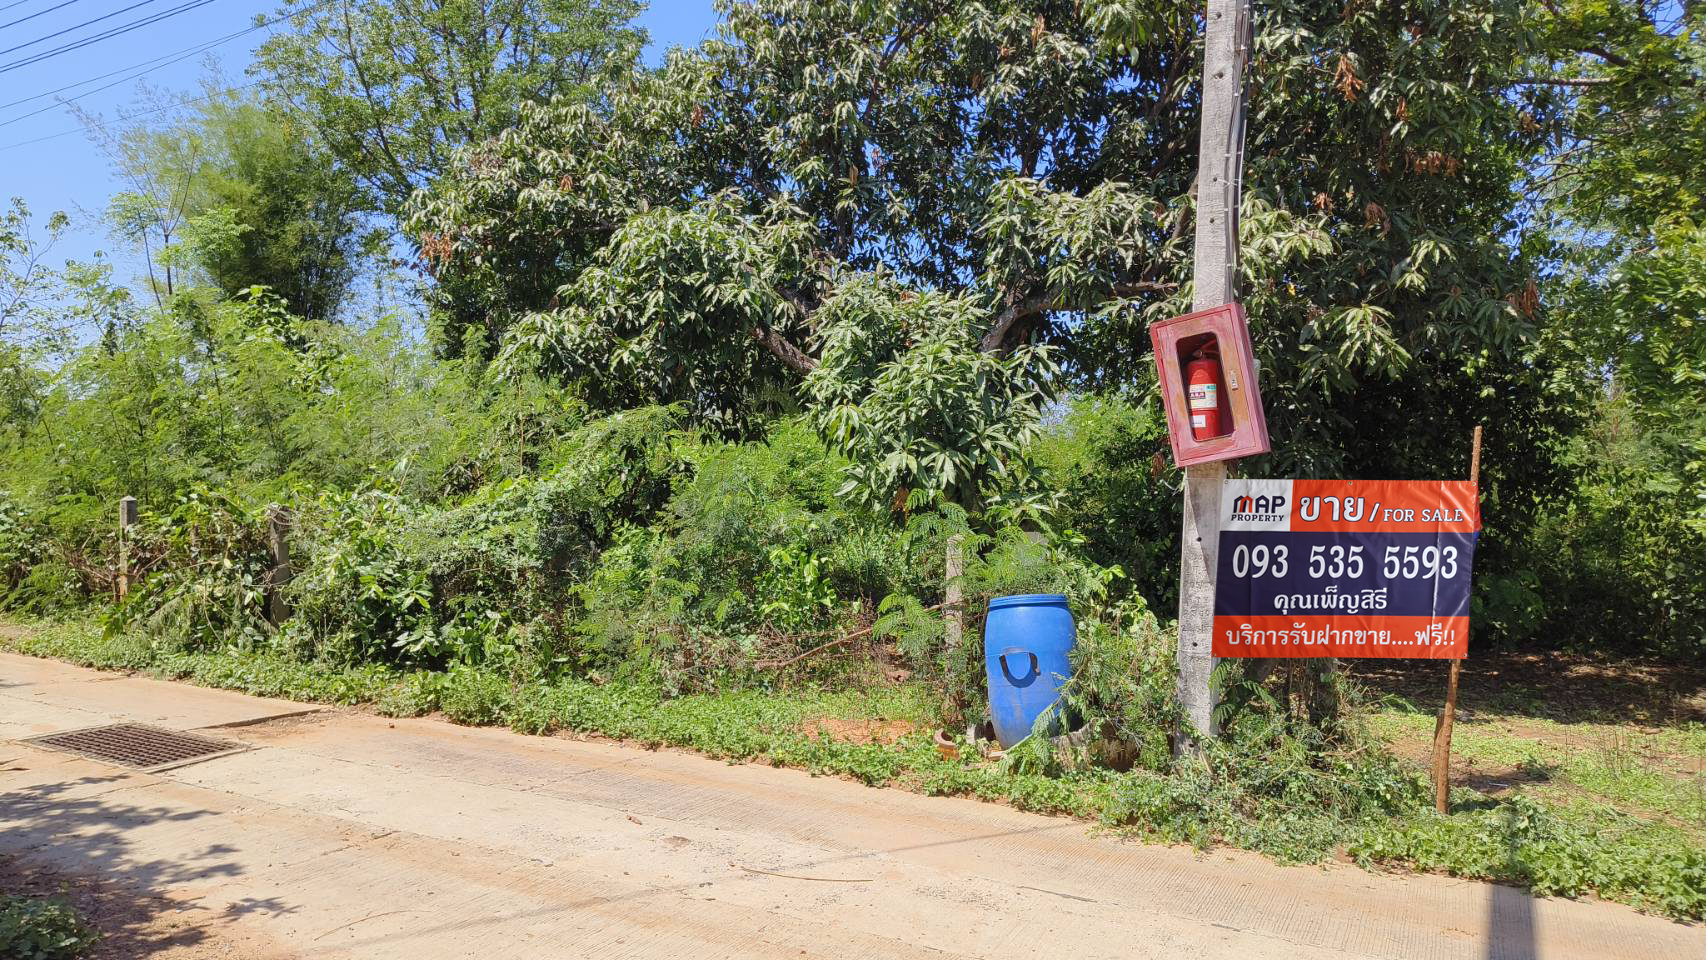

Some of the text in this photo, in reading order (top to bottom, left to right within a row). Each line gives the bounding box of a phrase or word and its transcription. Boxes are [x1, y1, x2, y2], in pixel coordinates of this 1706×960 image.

[1233, 495, 1286, 513] MAP
[1299, 496, 1365, 522] ขาย
[1383, 508, 1415, 522] FOR
[1421, 508, 1464, 522] SALE
[1231, 514, 1285, 522] PROPERTY
[1232, 544, 1458, 579] 093 535 5593
